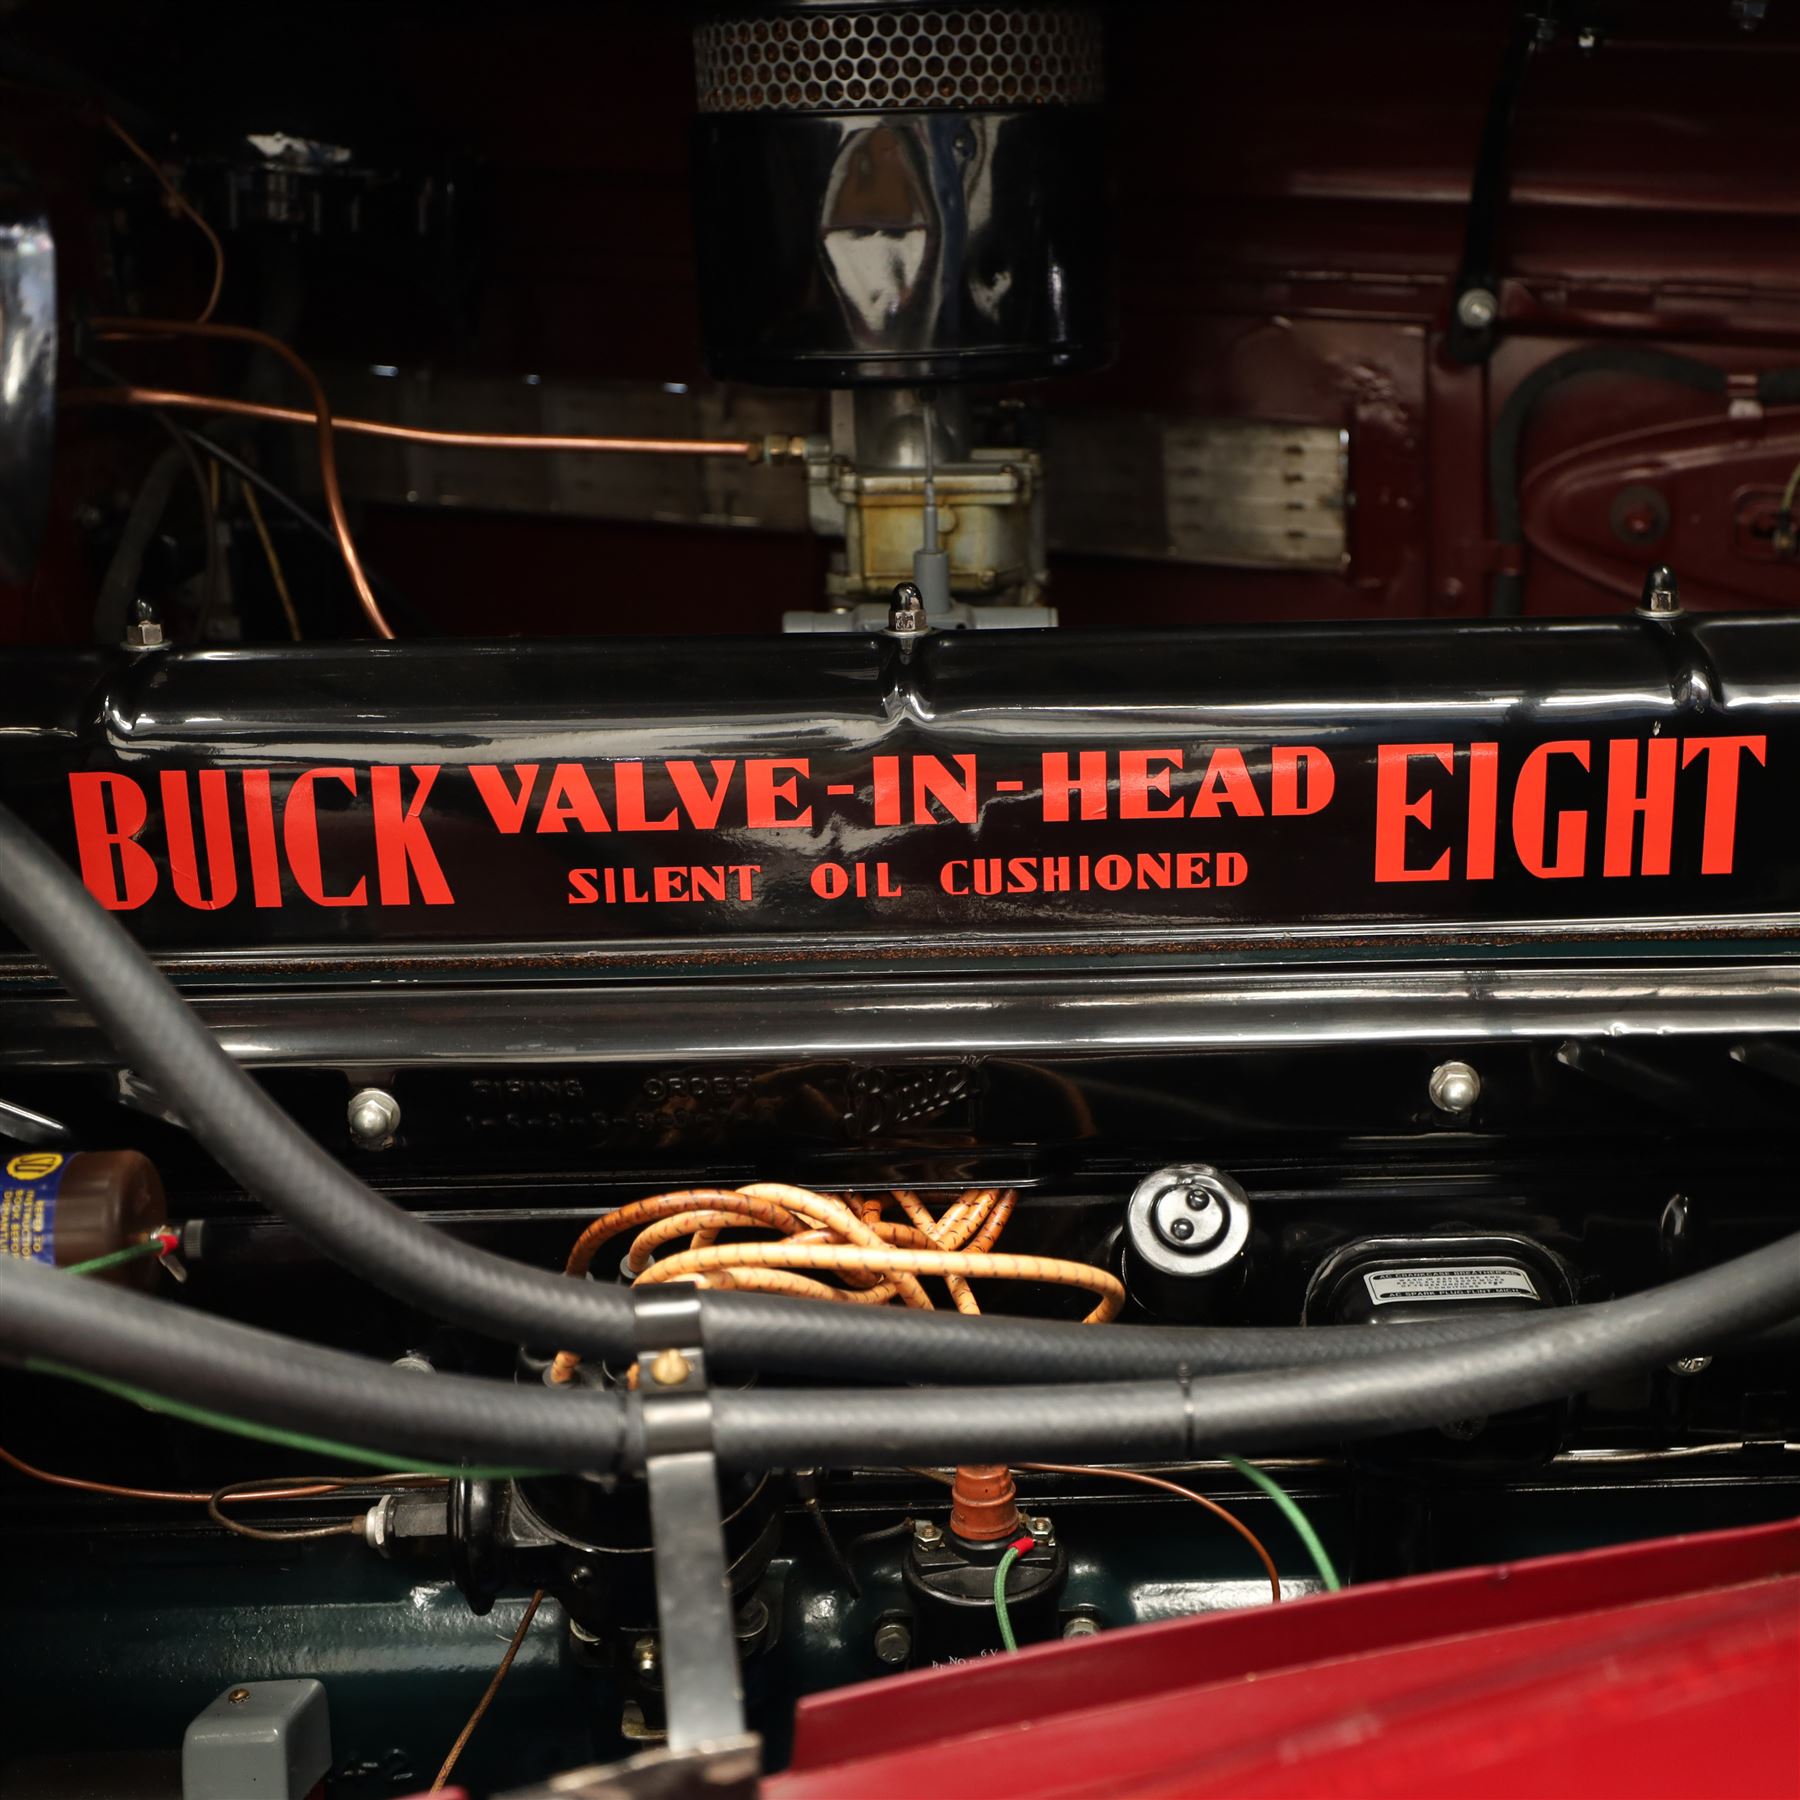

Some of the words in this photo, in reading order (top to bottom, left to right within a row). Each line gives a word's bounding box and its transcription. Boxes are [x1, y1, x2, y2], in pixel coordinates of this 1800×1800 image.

[69, 765, 454, 910] BUICK
[468, 747, 1335, 833] VALVE-IN-HEAD
[1375, 736, 1766, 882] EIGHT
[569, 865, 760, 903] SILENT
[811, 863, 901, 899] OIL
[941, 853, 1248, 895] CUSHIONED
